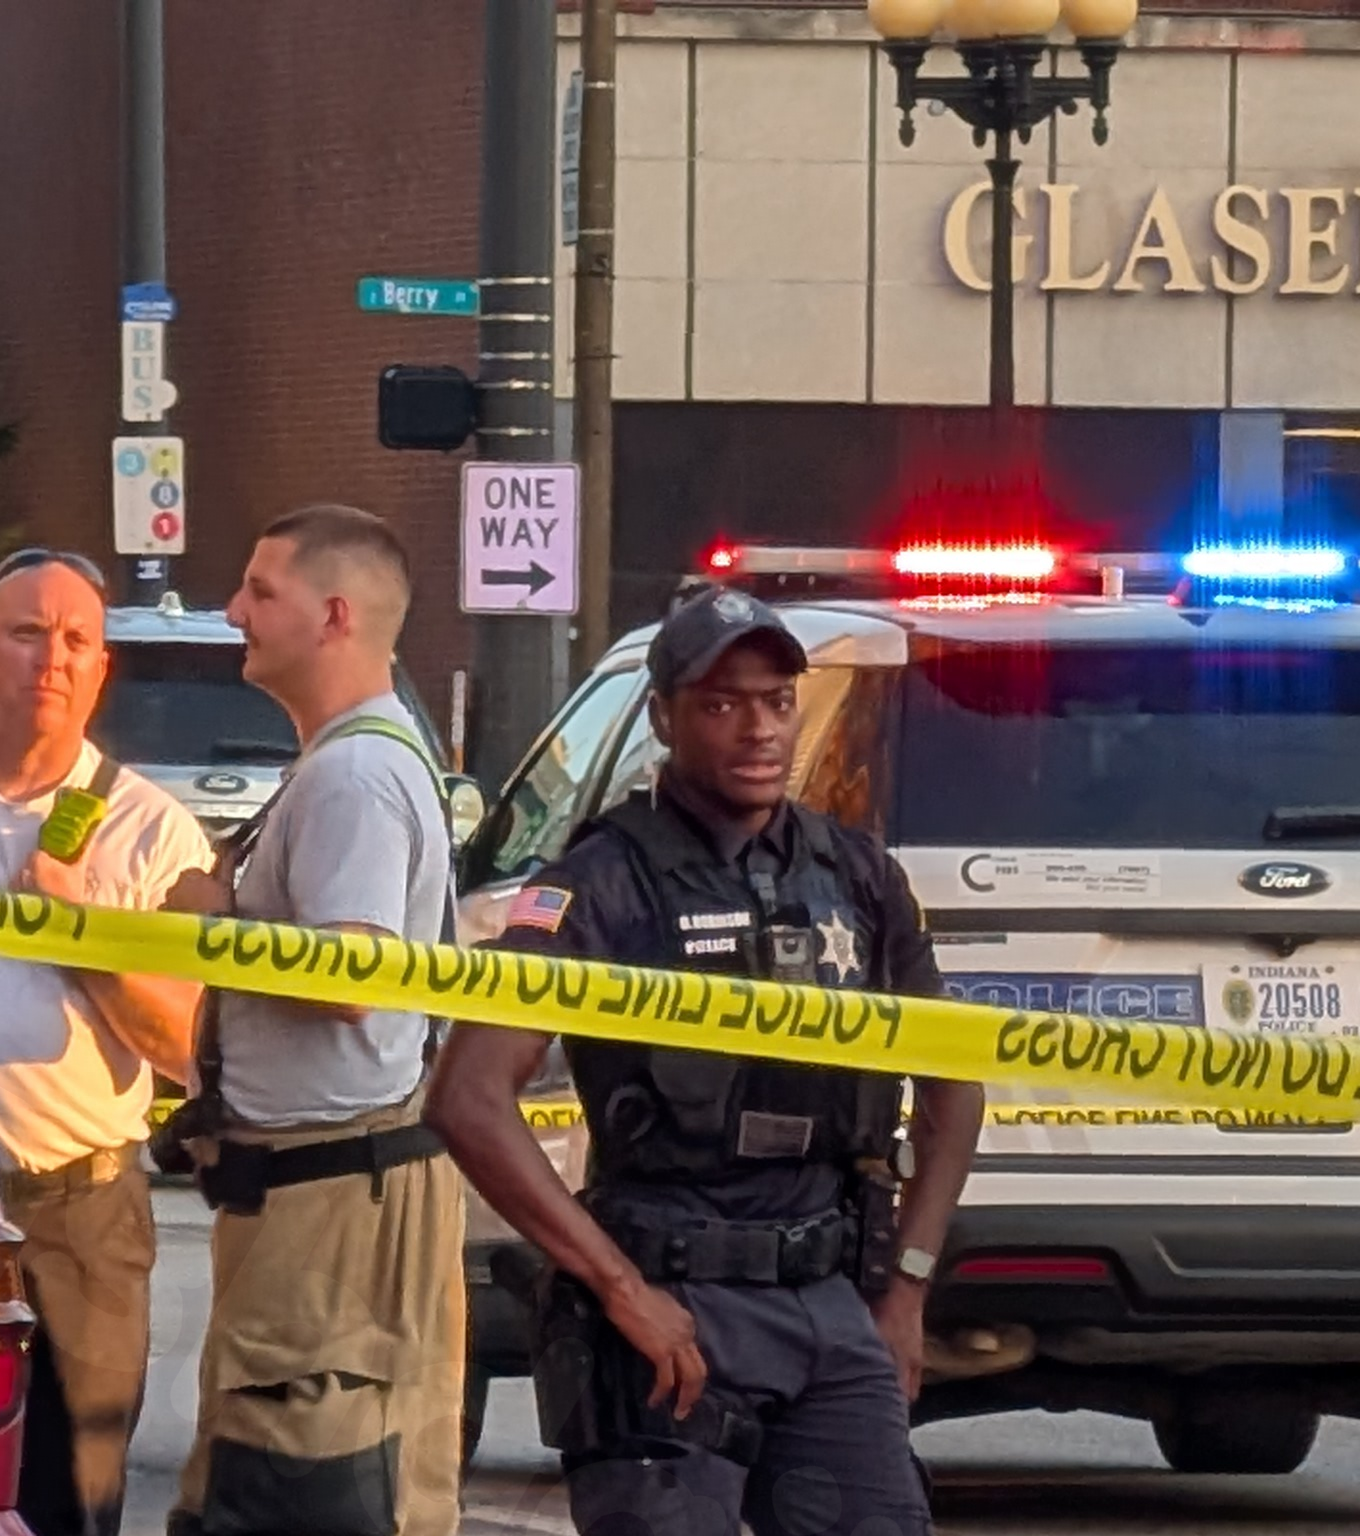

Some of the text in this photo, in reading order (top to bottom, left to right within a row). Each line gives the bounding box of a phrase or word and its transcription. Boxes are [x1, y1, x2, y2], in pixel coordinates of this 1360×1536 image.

[383, 280, 439, 310] Berry
[131, 327, 156, 410] BUS
[483, 477, 556, 512] ONE
[479, 517, 560, 551] WAY
[1258, 865, 1312, 889] Ford
[1248, 965, 1320, 979] INDIANA
[1258, 982, 1341, 1019] 20508
